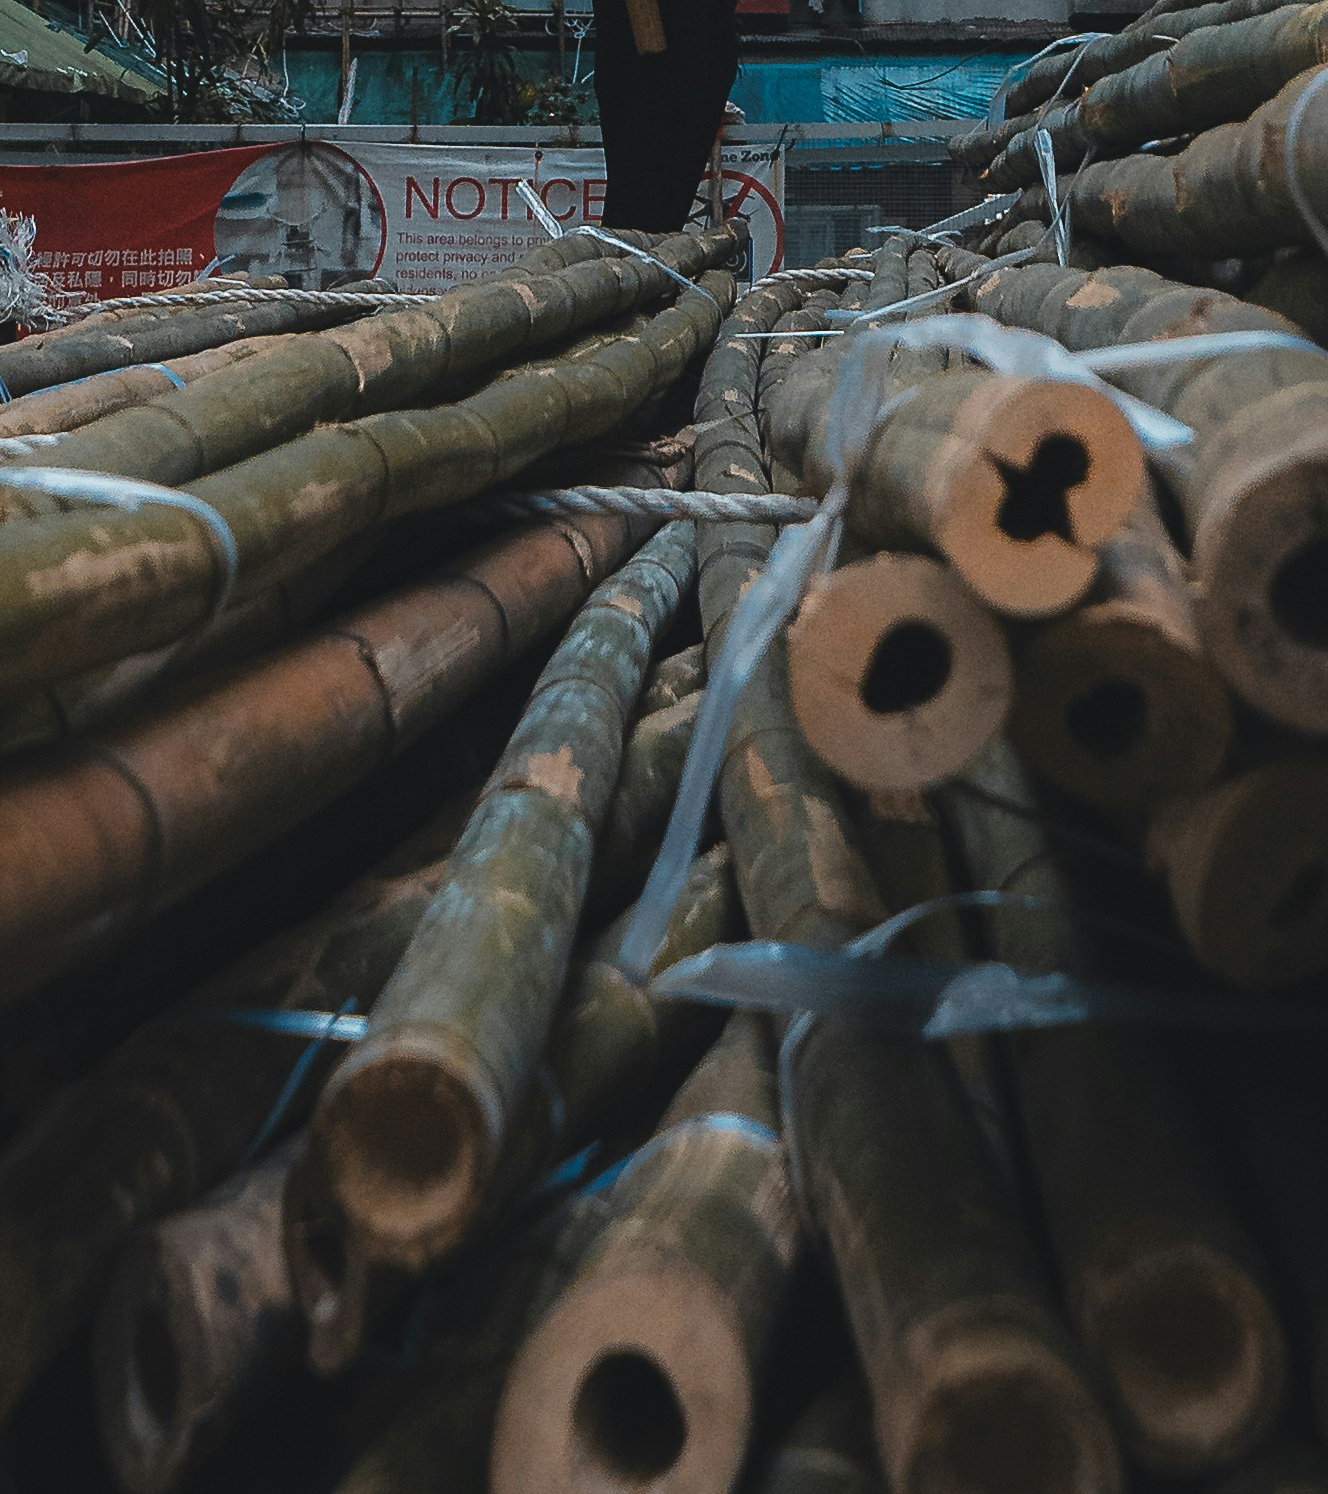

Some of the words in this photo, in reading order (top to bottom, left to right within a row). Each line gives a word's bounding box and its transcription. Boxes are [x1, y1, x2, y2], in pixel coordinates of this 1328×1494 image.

[740, 150, 778, 163] Zon
[405, 176, 608, 222] NOTICE
[397, 231, 423, 245] This
[427, 234, 455, 245] area
[458, 232, 509, 249] belongs
[511, 234, 523, 246] to
[396, 250, 439, 264] protect
[443, 251, 488, 266] privacy
[491, 251, 515, 264] and
[460, 269, 478, 280] no
